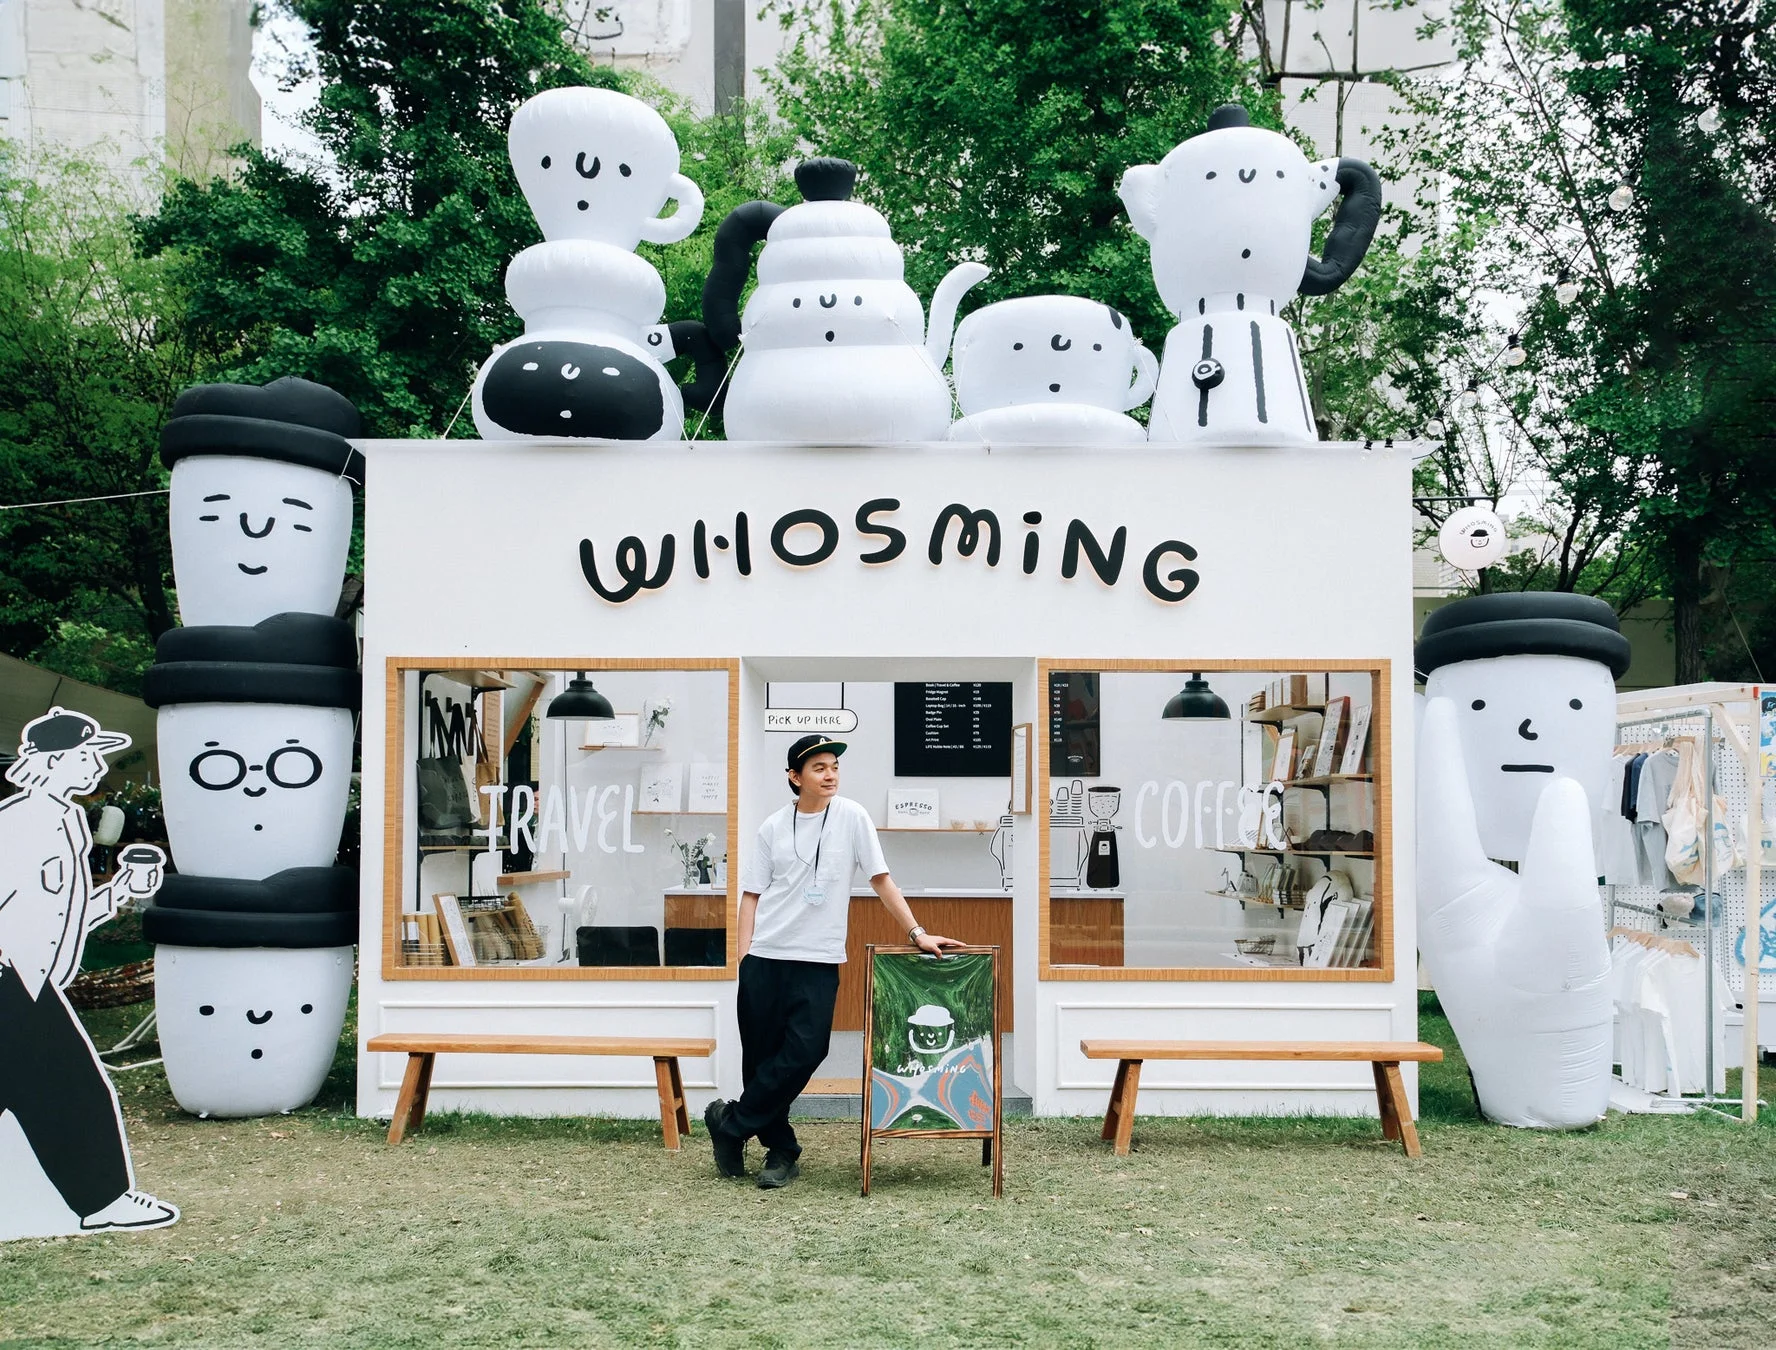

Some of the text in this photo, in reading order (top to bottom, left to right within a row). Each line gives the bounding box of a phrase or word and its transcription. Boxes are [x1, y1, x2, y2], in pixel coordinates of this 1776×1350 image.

[1459, 519, 1498, 535] WHOSMING
[579, 498, 1200, 603] WHOSMING
[797, 715, 811, 725] UP
[815, 715, 842, 725] HERE
[480, 783, 645, 855] TRAVEL
[895, 802, 932, 812] ESPRESSO
[1134, 779, 1288, 851] COFFEE
